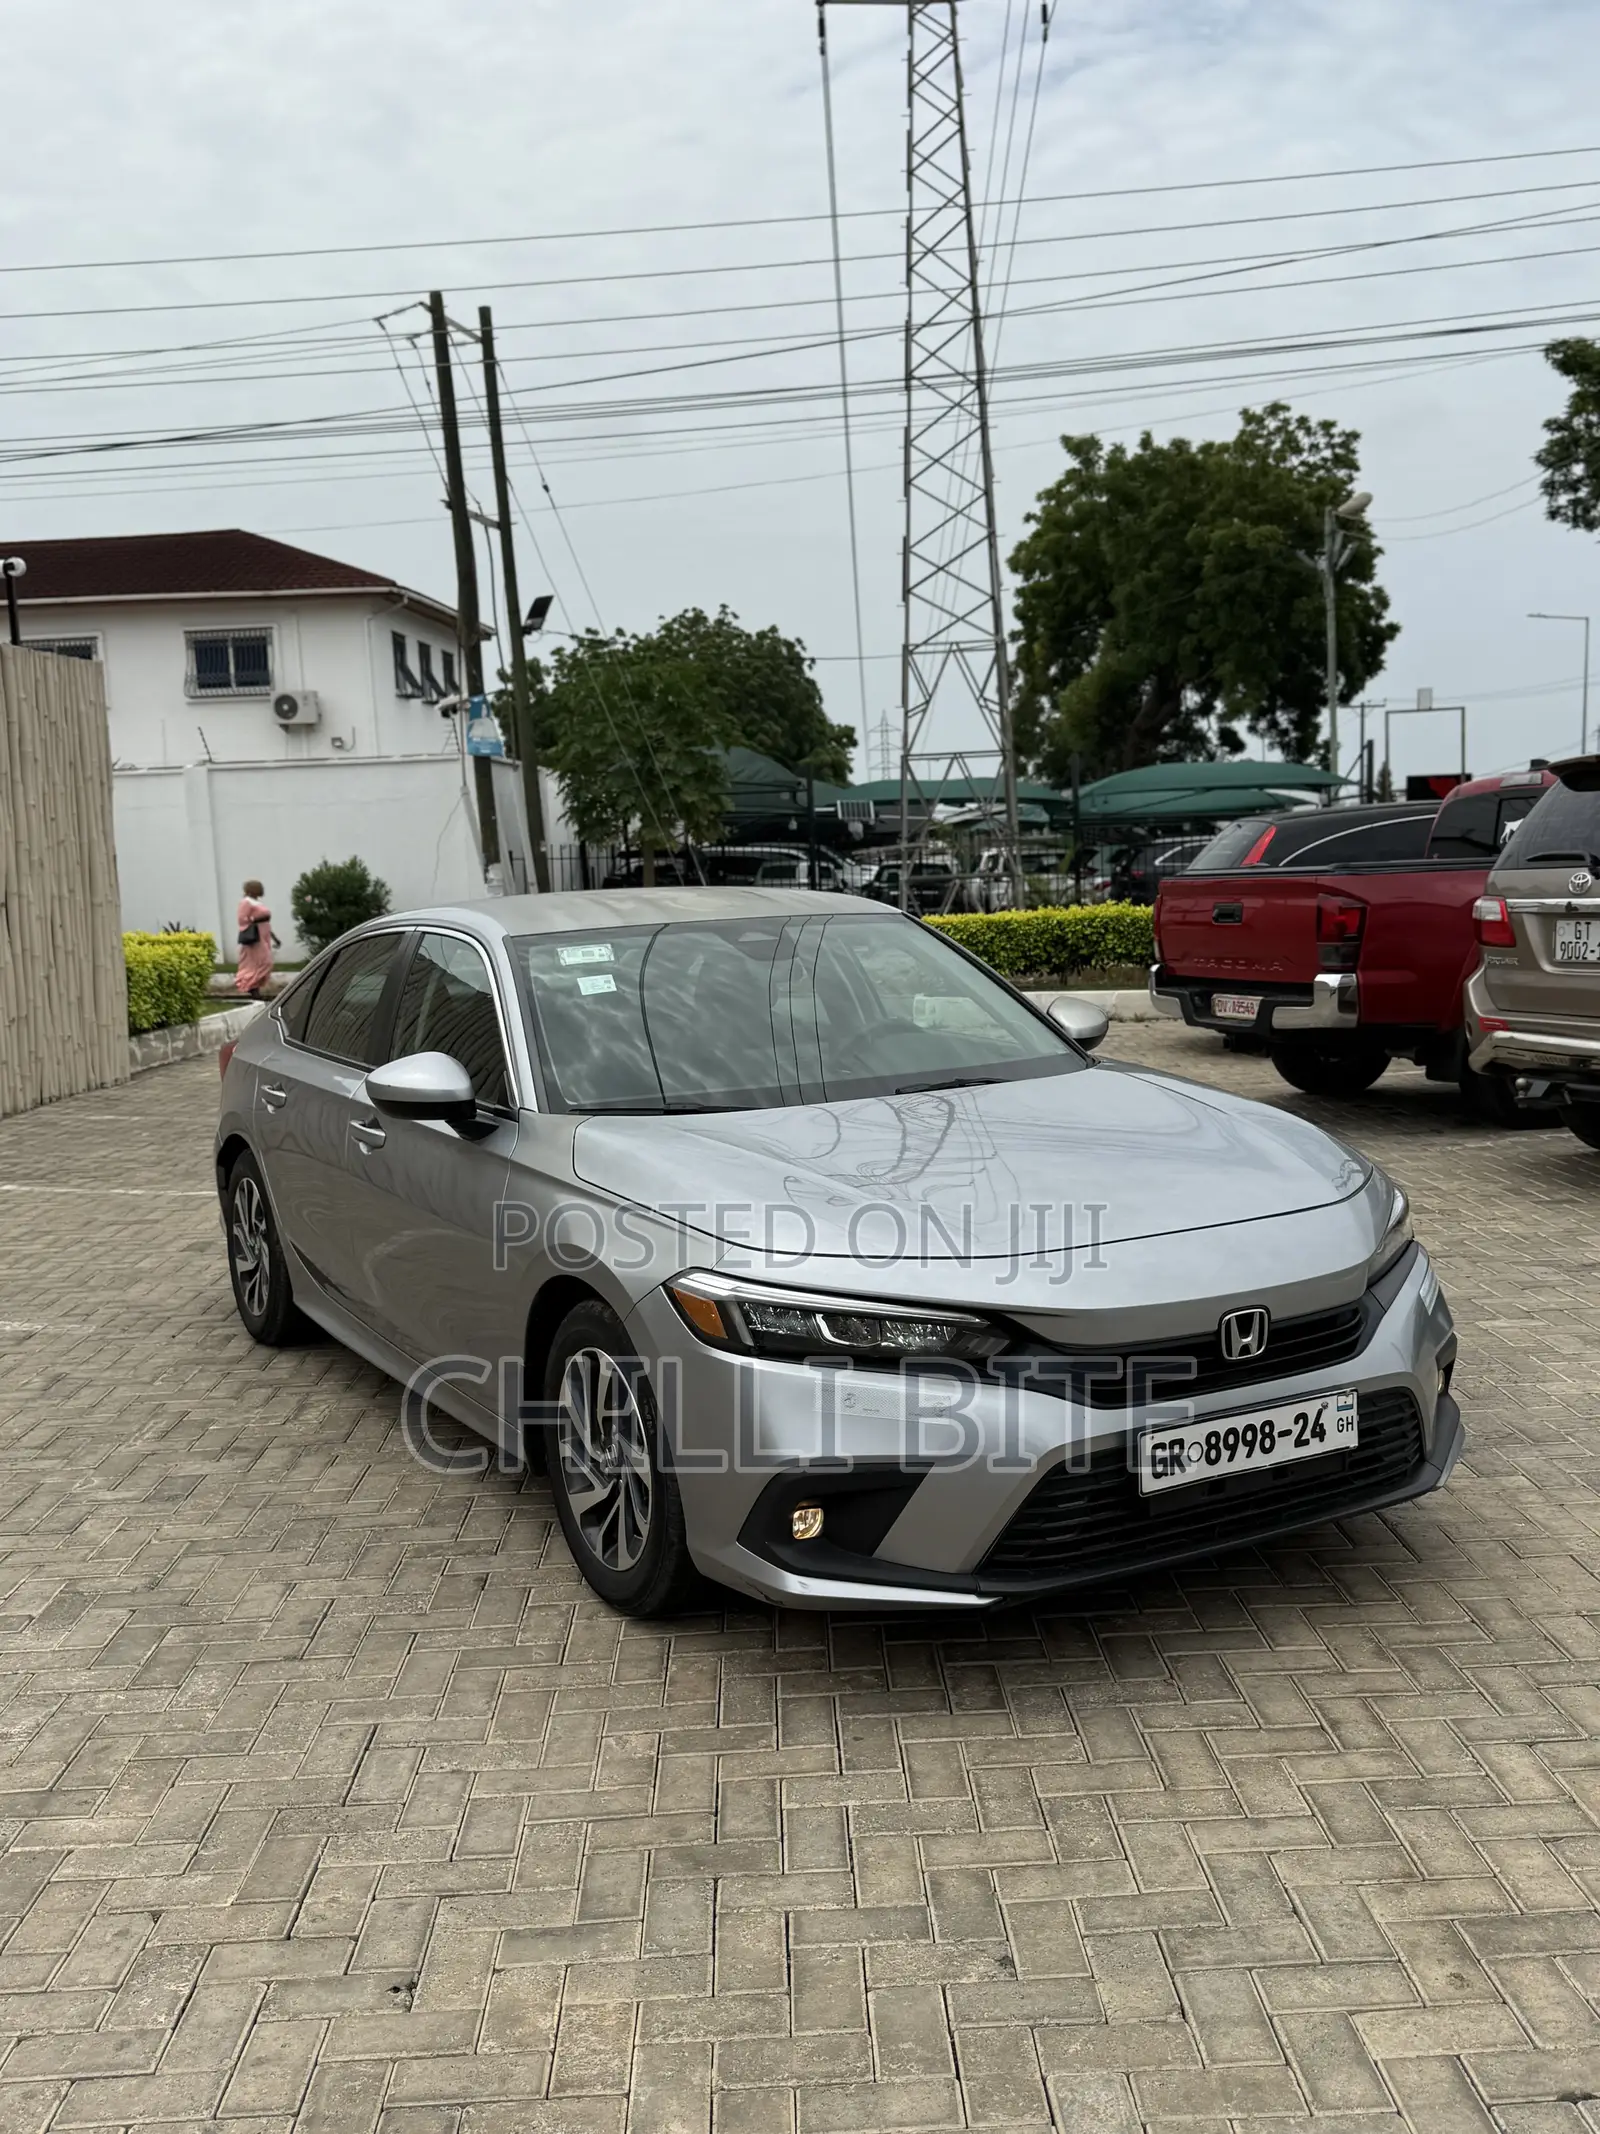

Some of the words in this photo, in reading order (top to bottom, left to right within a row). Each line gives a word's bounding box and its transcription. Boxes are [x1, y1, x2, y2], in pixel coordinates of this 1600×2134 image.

[1574, 921, 1591, 940] GT
[1193, 957, 1284, 972] TACOMA
[1336, 1415, 1355, 1433] GH
